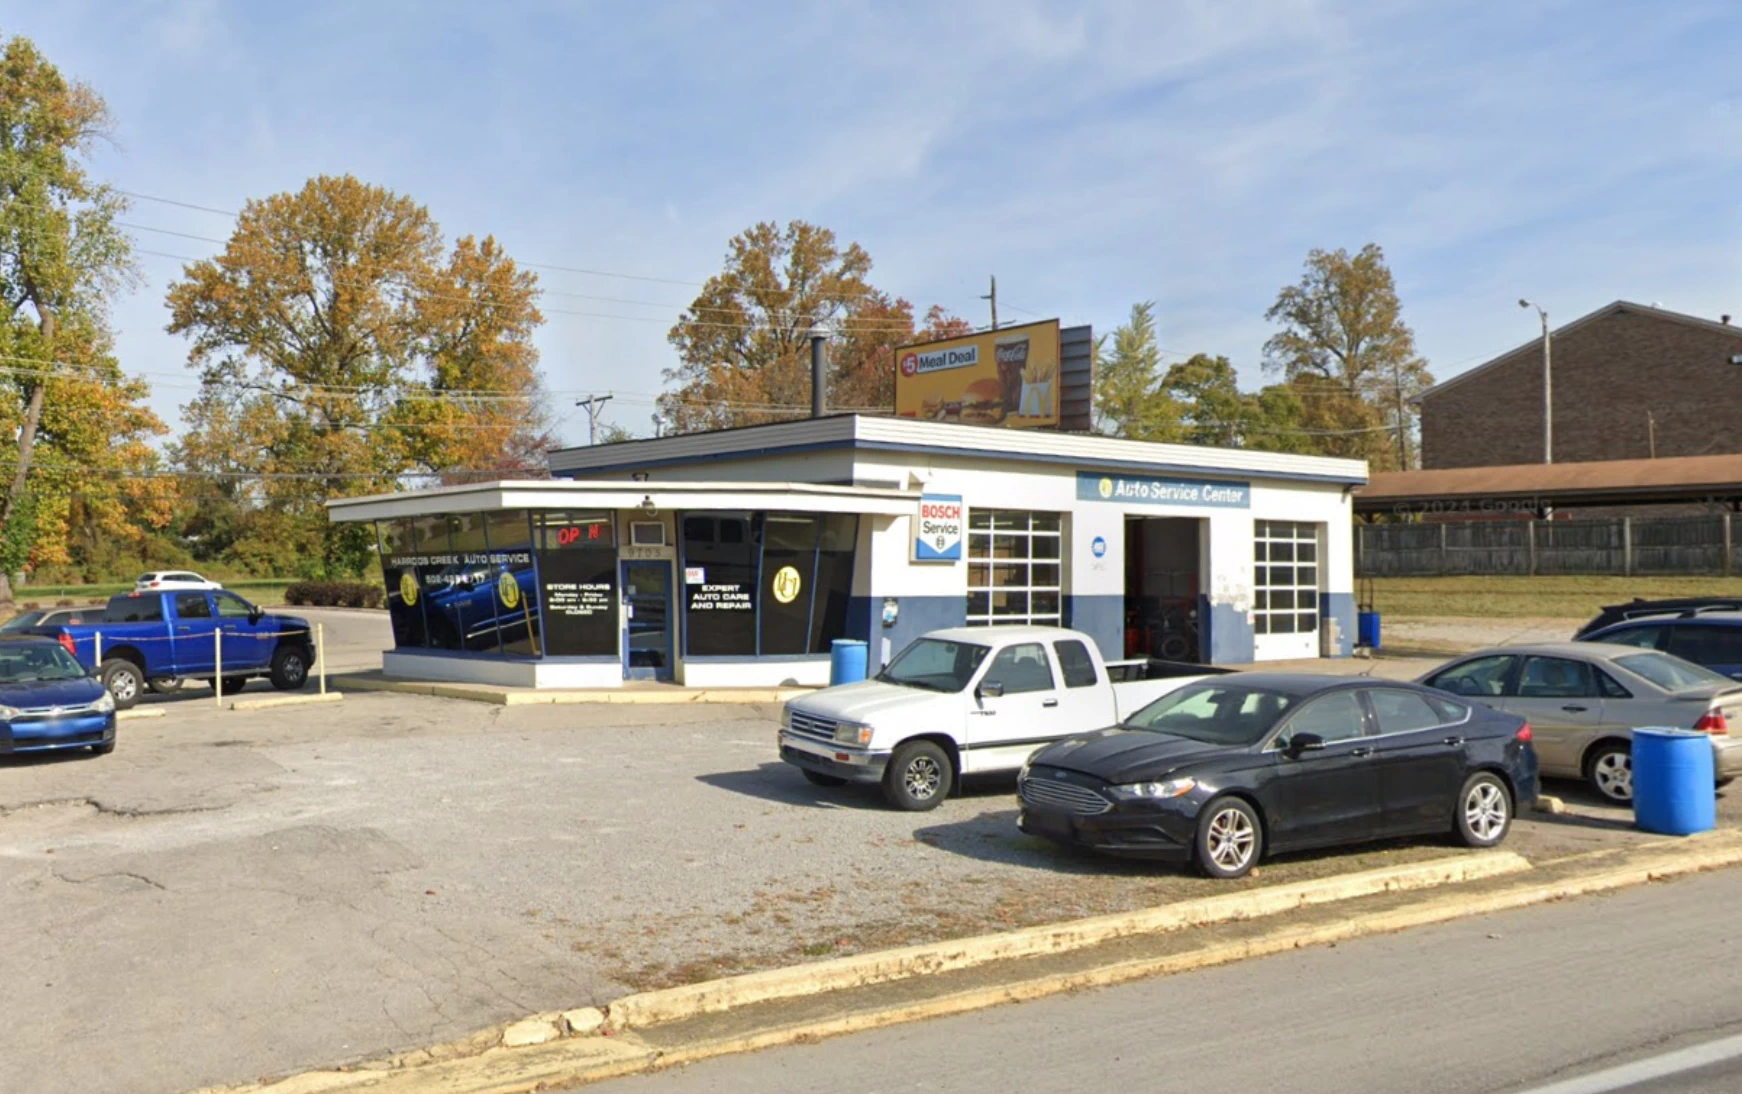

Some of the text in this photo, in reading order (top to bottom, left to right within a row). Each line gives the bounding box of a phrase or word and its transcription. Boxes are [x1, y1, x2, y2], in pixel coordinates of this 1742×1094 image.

[919, 353, 946, 369] Meal
[949, 348, 975, 364] Deal
[1115, 479, 1243, 502] Auto Service Center
[921, 504, 961, 519] BOSCH
[557, 523, 600, 546] OPN
[923, 520, 959, 535] Service
[430, 555, 459, 565] CREEK
[463, 554, 487, 564] AUTO
[489, 553, 530, 564] SERVICE
[701, 584, 741, 592] EXPERT
[692, 593, 750, 601] AUTO CARE
[691, 602, 752, 610] AND REPAIR
